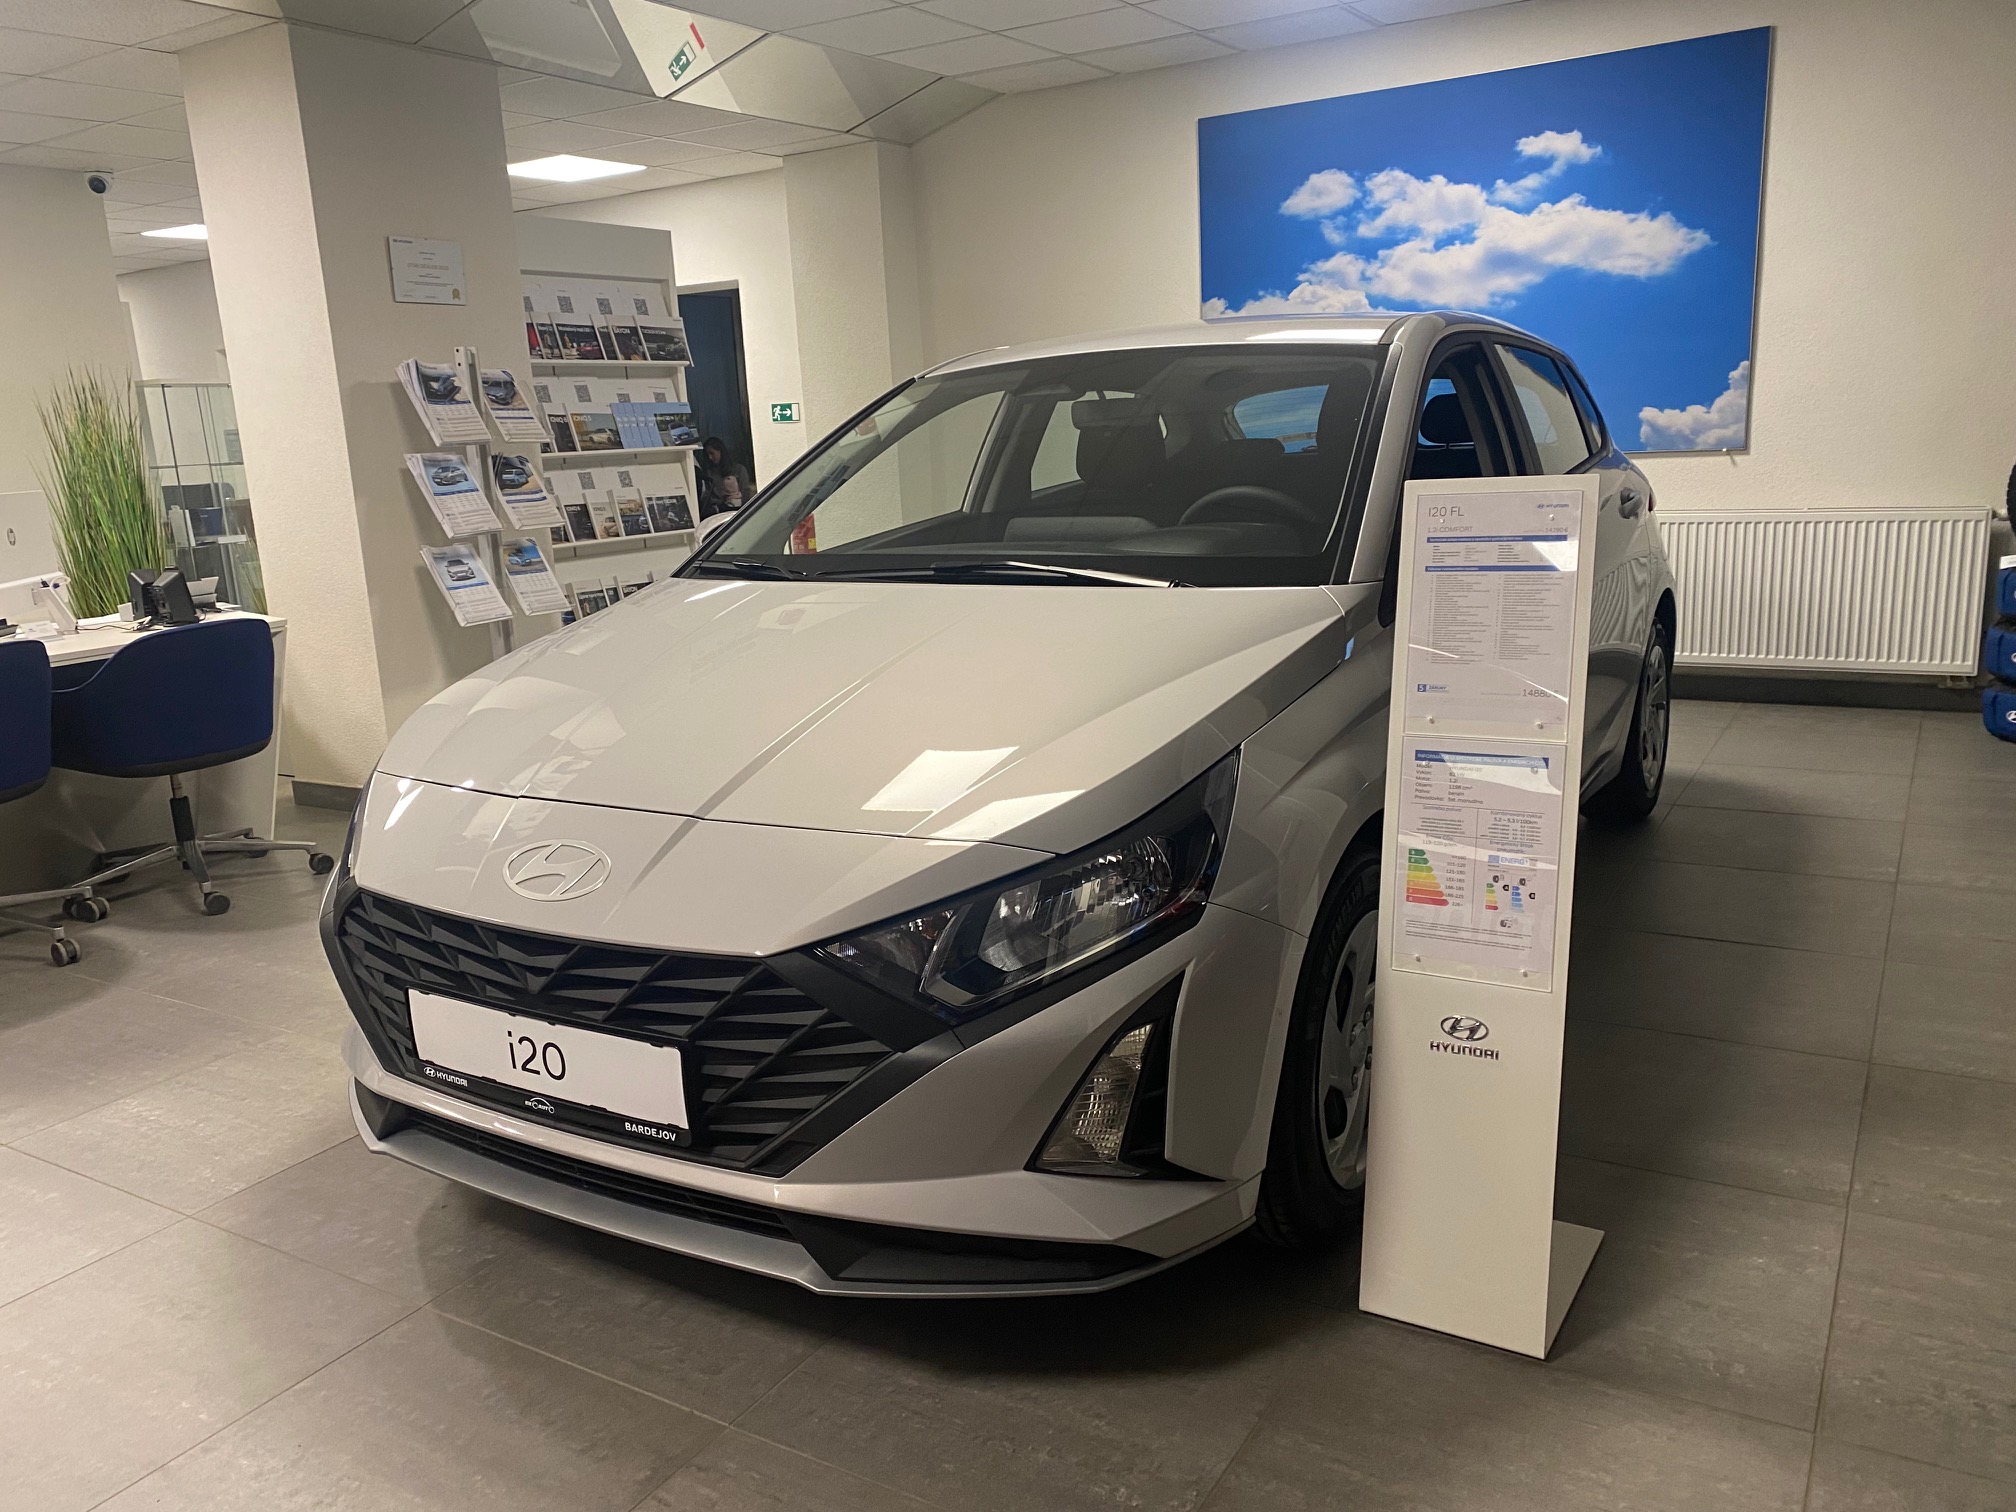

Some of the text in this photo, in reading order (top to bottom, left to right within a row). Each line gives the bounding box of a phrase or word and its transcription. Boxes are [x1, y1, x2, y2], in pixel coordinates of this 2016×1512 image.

[1450, 506, 1464, 517] FL
[1500, 857, 1525, 865] ENERG
[506, 1030, 567, 1081] i20
[1430, 1040, 1499, 1061] HYUNDAI
[436, 1070, 468, 1087] HYUNDAI
[625, 1122, 676, 1142] BARDEJOV
